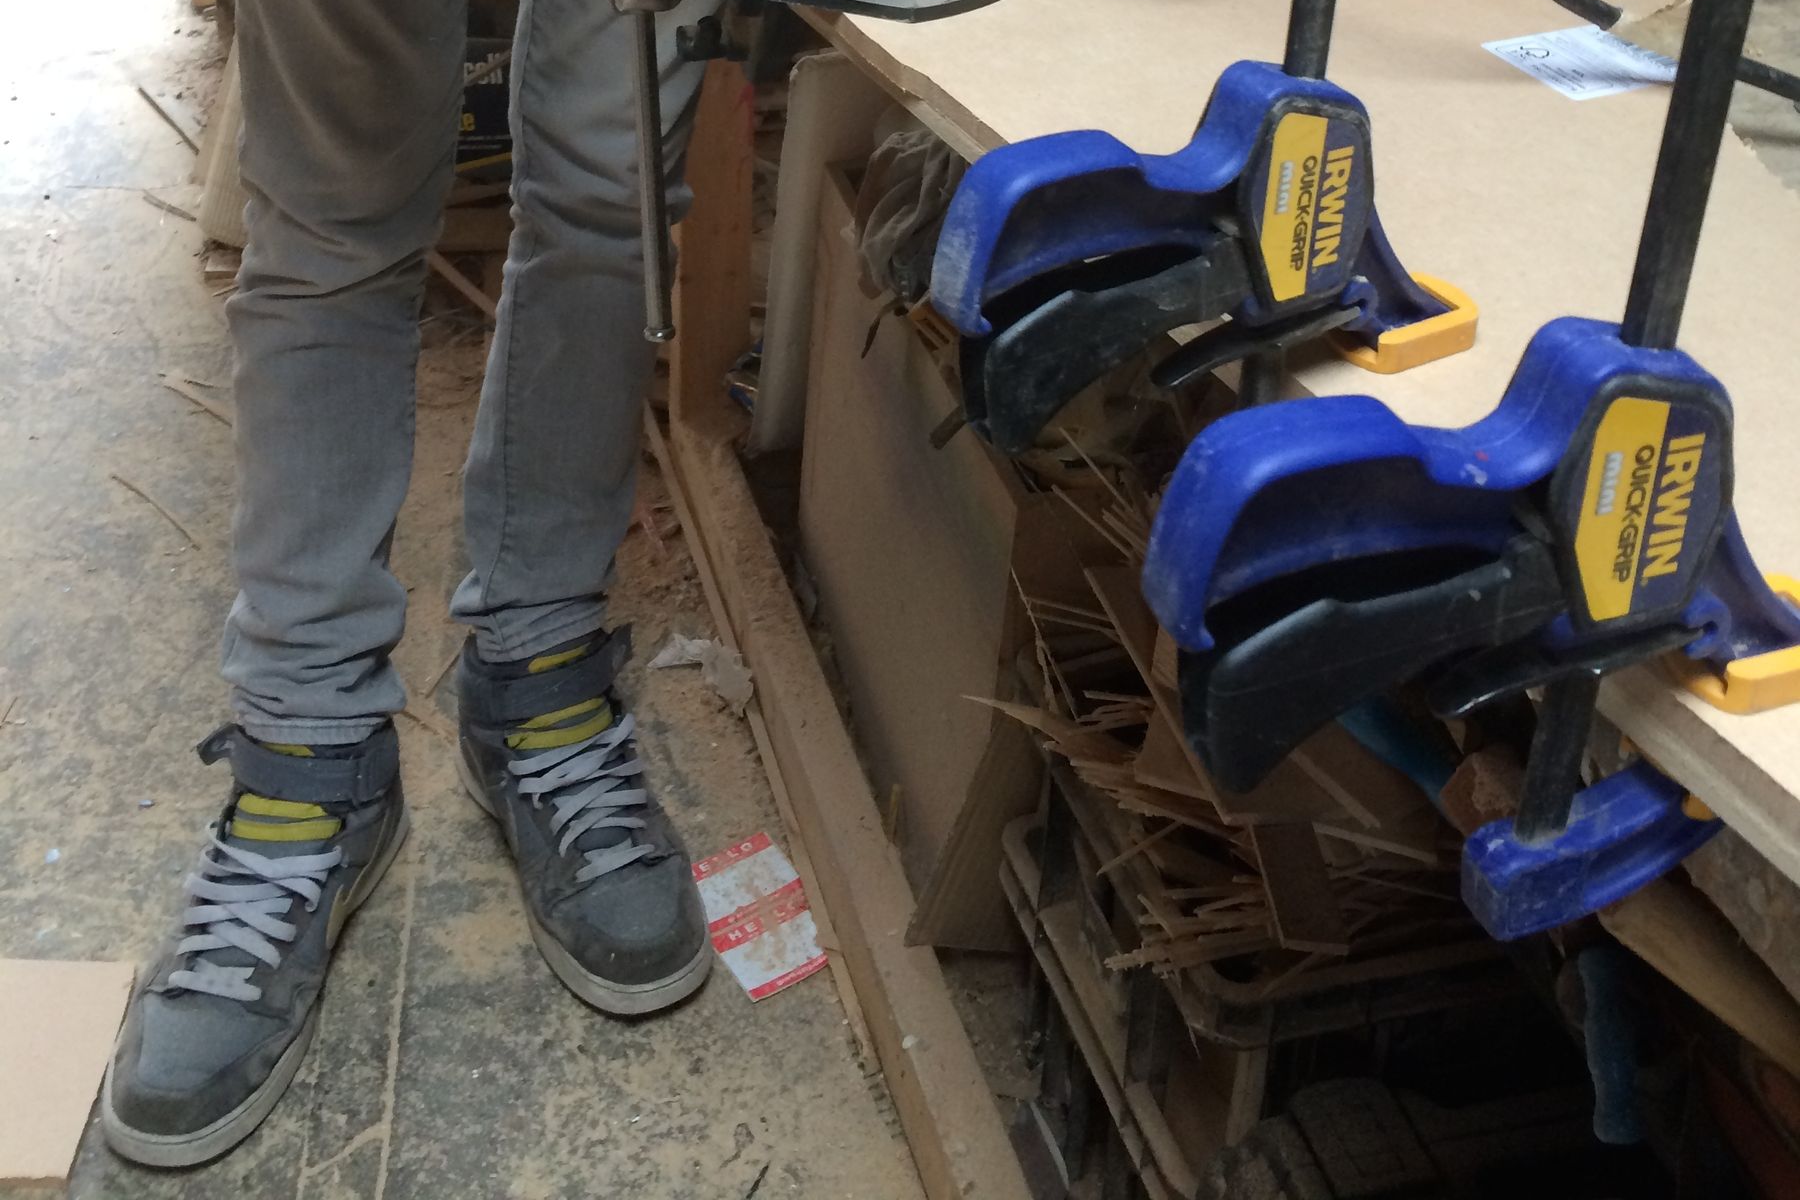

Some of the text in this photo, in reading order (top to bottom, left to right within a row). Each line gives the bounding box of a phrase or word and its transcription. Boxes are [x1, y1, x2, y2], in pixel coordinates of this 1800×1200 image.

[1290, 155, 1318, 272] QUICK-GRIP
[1312, 145, 1355, 267] IRWIN
[1613, 444, 1655, 583] QUICK-GRIP
[1643, 432, 1706, 579] IRWIN
